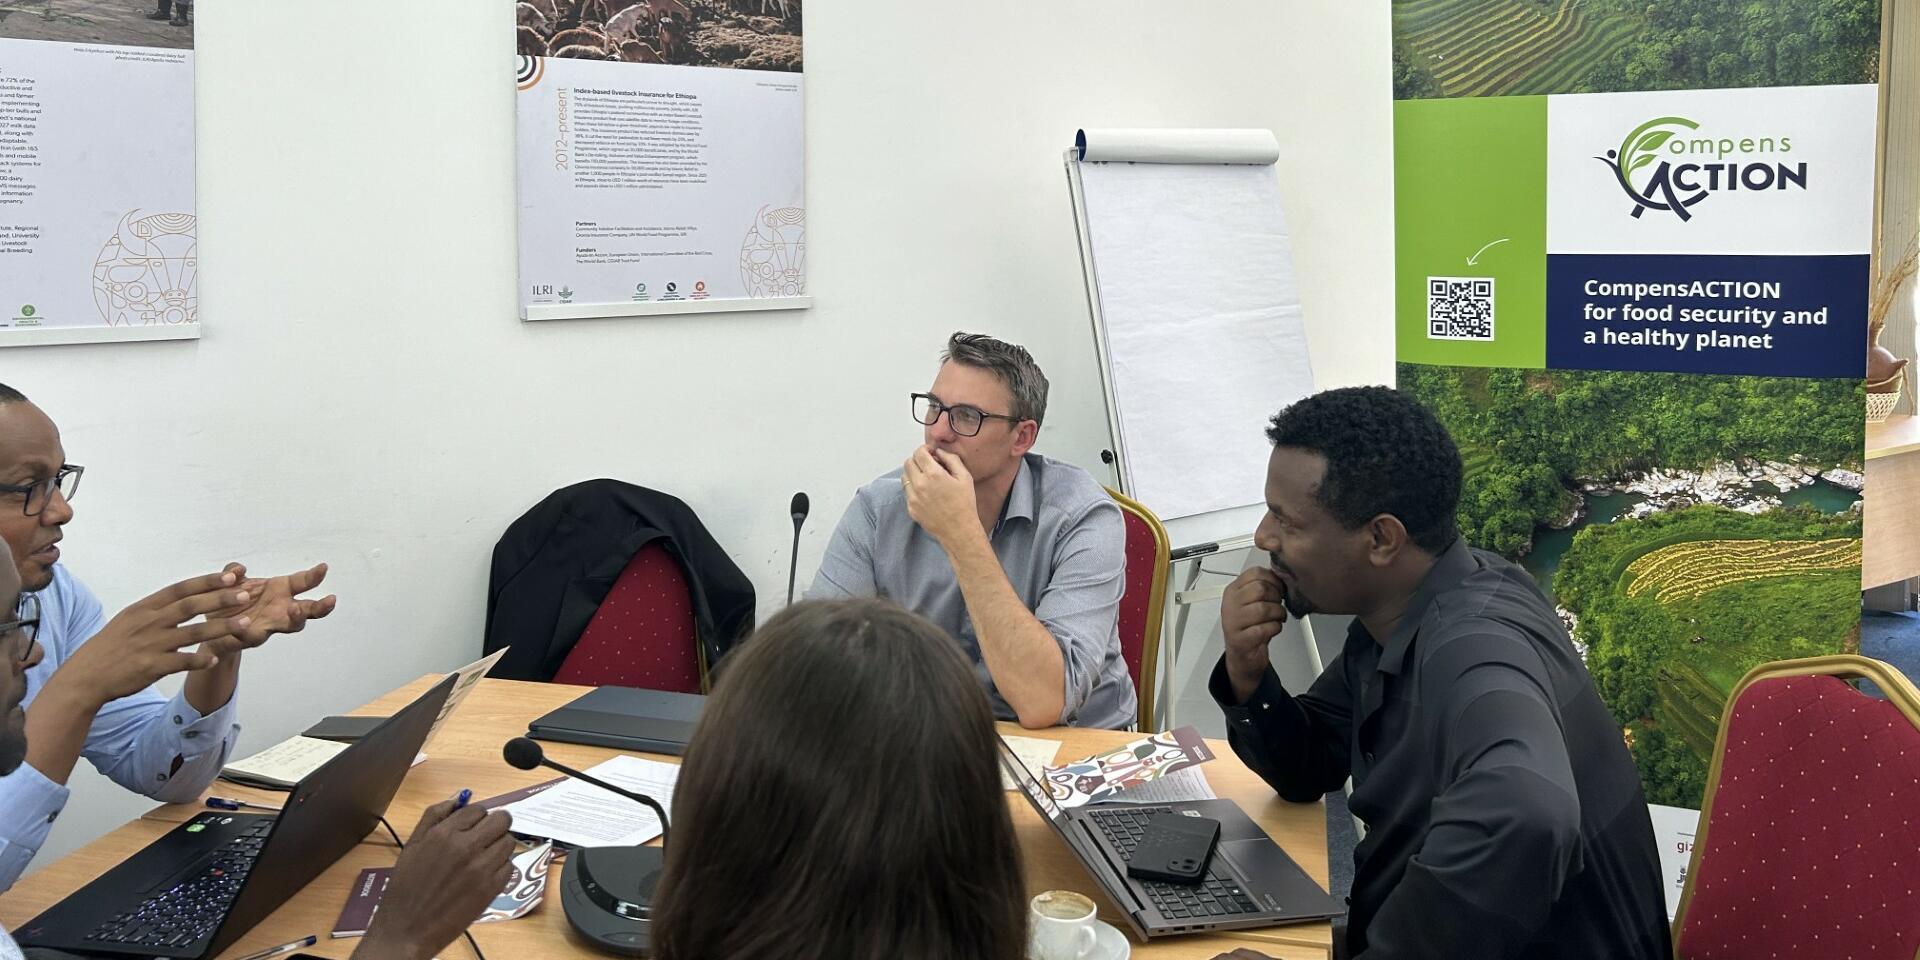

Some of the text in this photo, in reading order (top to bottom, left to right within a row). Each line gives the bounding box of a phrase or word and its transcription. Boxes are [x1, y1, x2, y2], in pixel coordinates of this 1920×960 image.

[1630, 161, 1808, 222] ACTION
[533, 285, 552, 295] ILRI
[1584, 280, 1780, 301] CompensACTION
[1584, 303, 1828, 329] for food security and
[1584, 328, 1773, 351] a healthy planet
